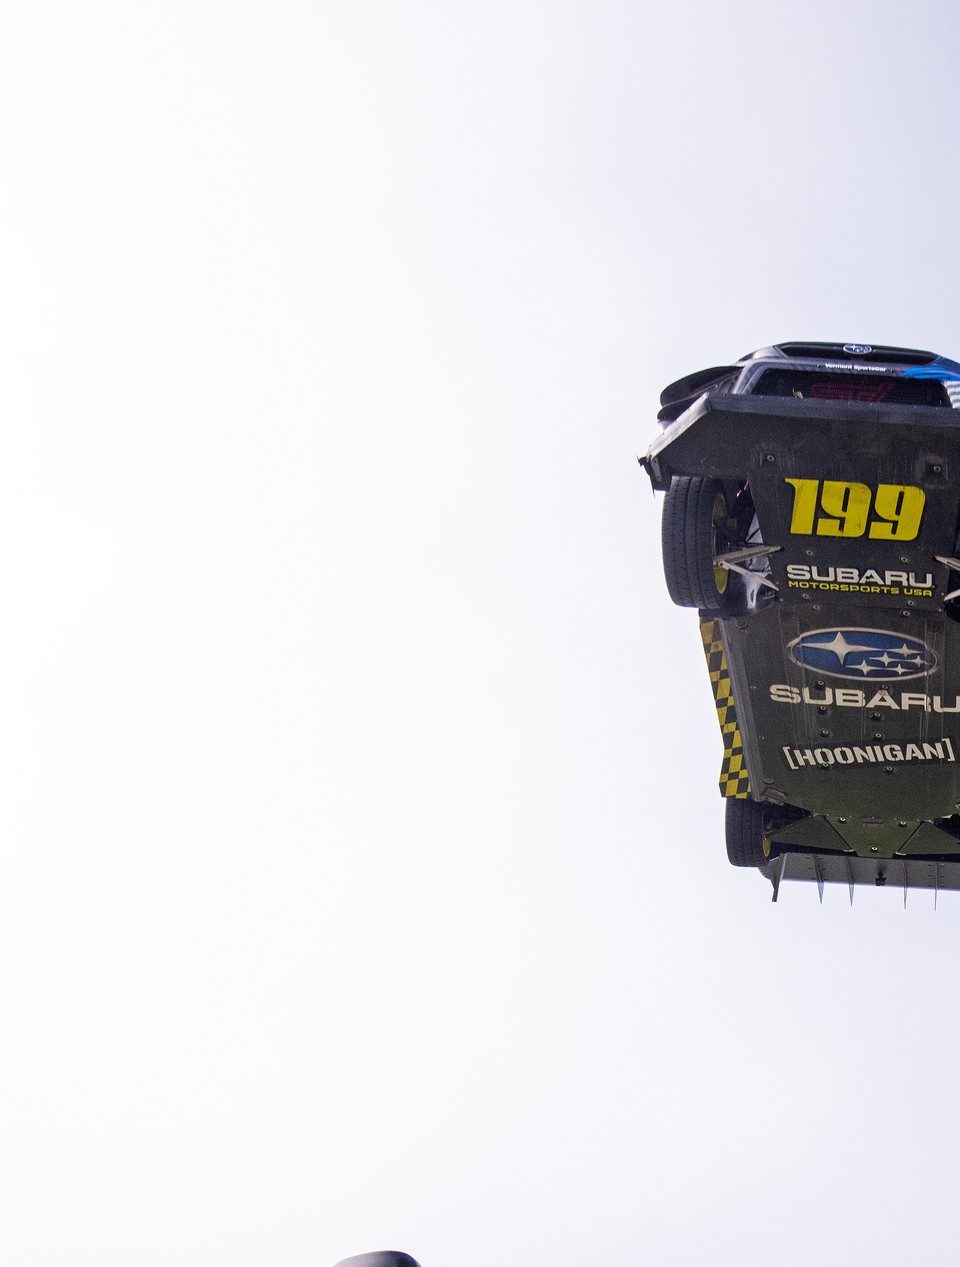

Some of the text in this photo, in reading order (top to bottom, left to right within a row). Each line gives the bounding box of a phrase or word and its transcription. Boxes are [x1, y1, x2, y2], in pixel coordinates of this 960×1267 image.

[825, 362, 853, 370] Vermont
[784, 477, 926, 542] 199
[786, 564, 933, 589] SUBARU
[788, 580, 933, 597] MOTORSPORTS USA
[782, 737, 956, 770] [HOONIGAN]
